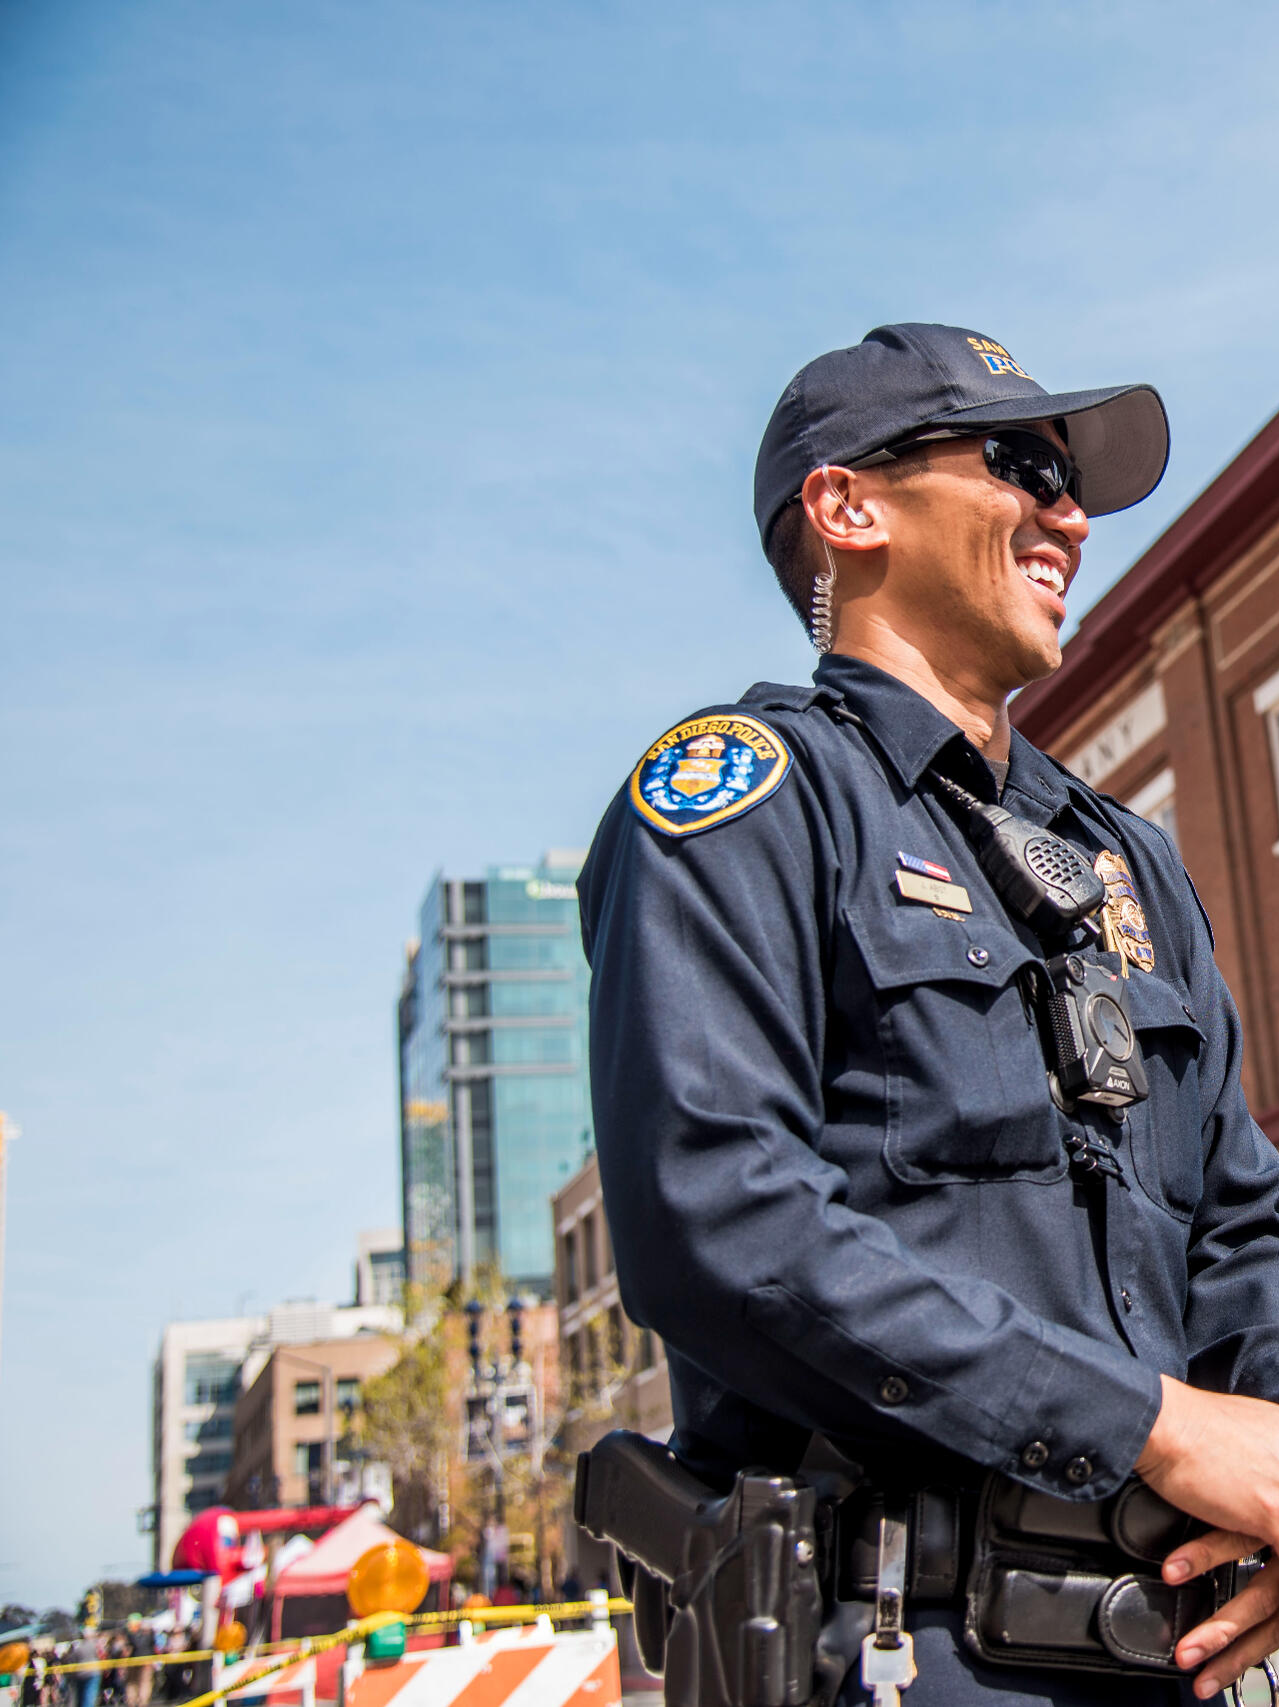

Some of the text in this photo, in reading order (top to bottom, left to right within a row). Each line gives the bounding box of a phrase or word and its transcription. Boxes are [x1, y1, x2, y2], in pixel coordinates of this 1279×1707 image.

[646, 720, 777, 761] SAN DIEGO POLICE
[1113, 1078, 1130, 1091] AXON
